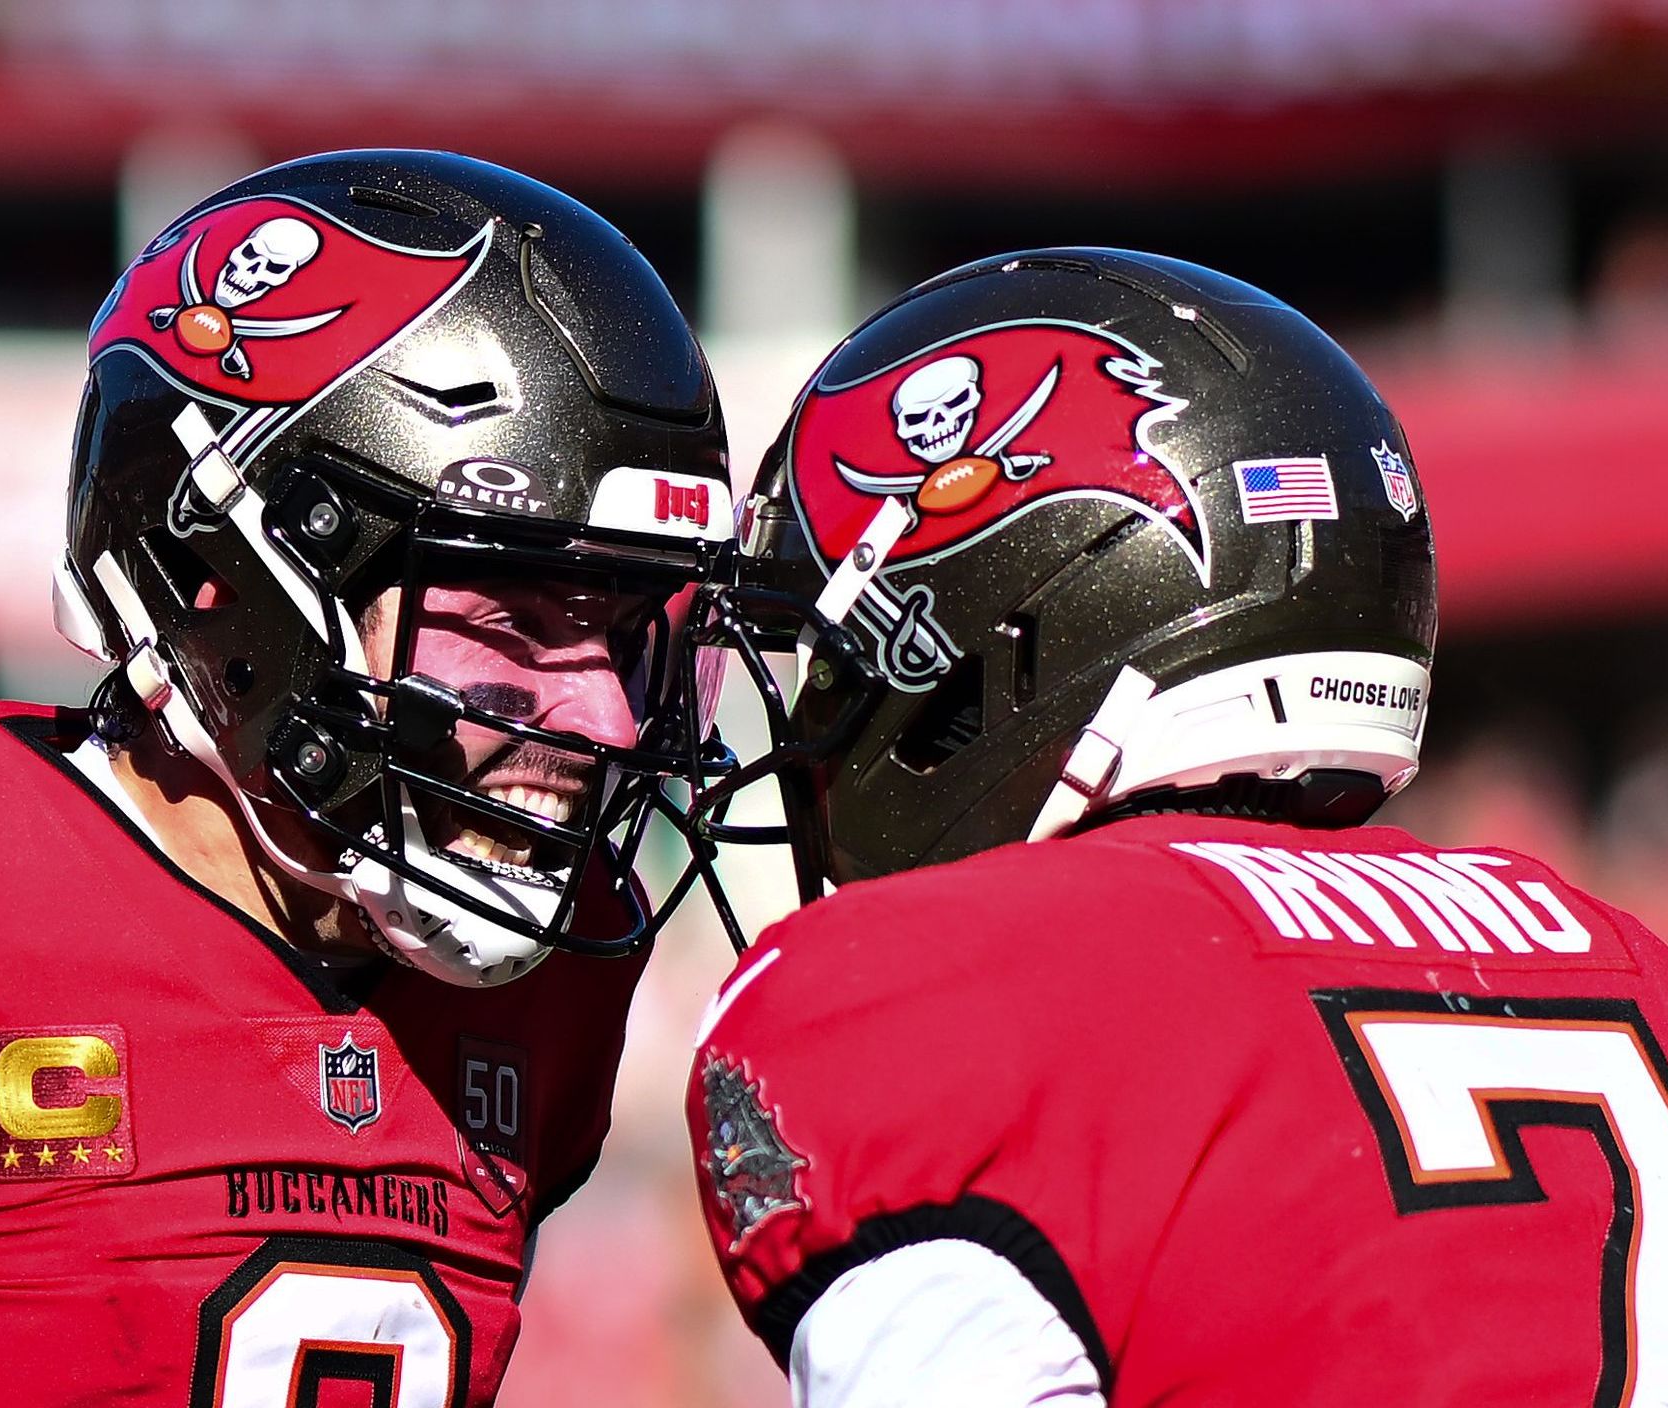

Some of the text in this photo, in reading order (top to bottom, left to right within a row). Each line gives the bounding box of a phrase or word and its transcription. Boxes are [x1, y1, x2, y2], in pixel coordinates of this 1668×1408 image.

[440, 479, 544, 513] OAKLEY
[1310, 676, 1421, 711] CHOOSE LOVE
[1169, 842, 1592, 954] IRVING
[331, 1079, 373, 1117] NFL
[465, 1059, 518, 1136] 50
[227, 1170, 449, 1237] BUCCANEERS
